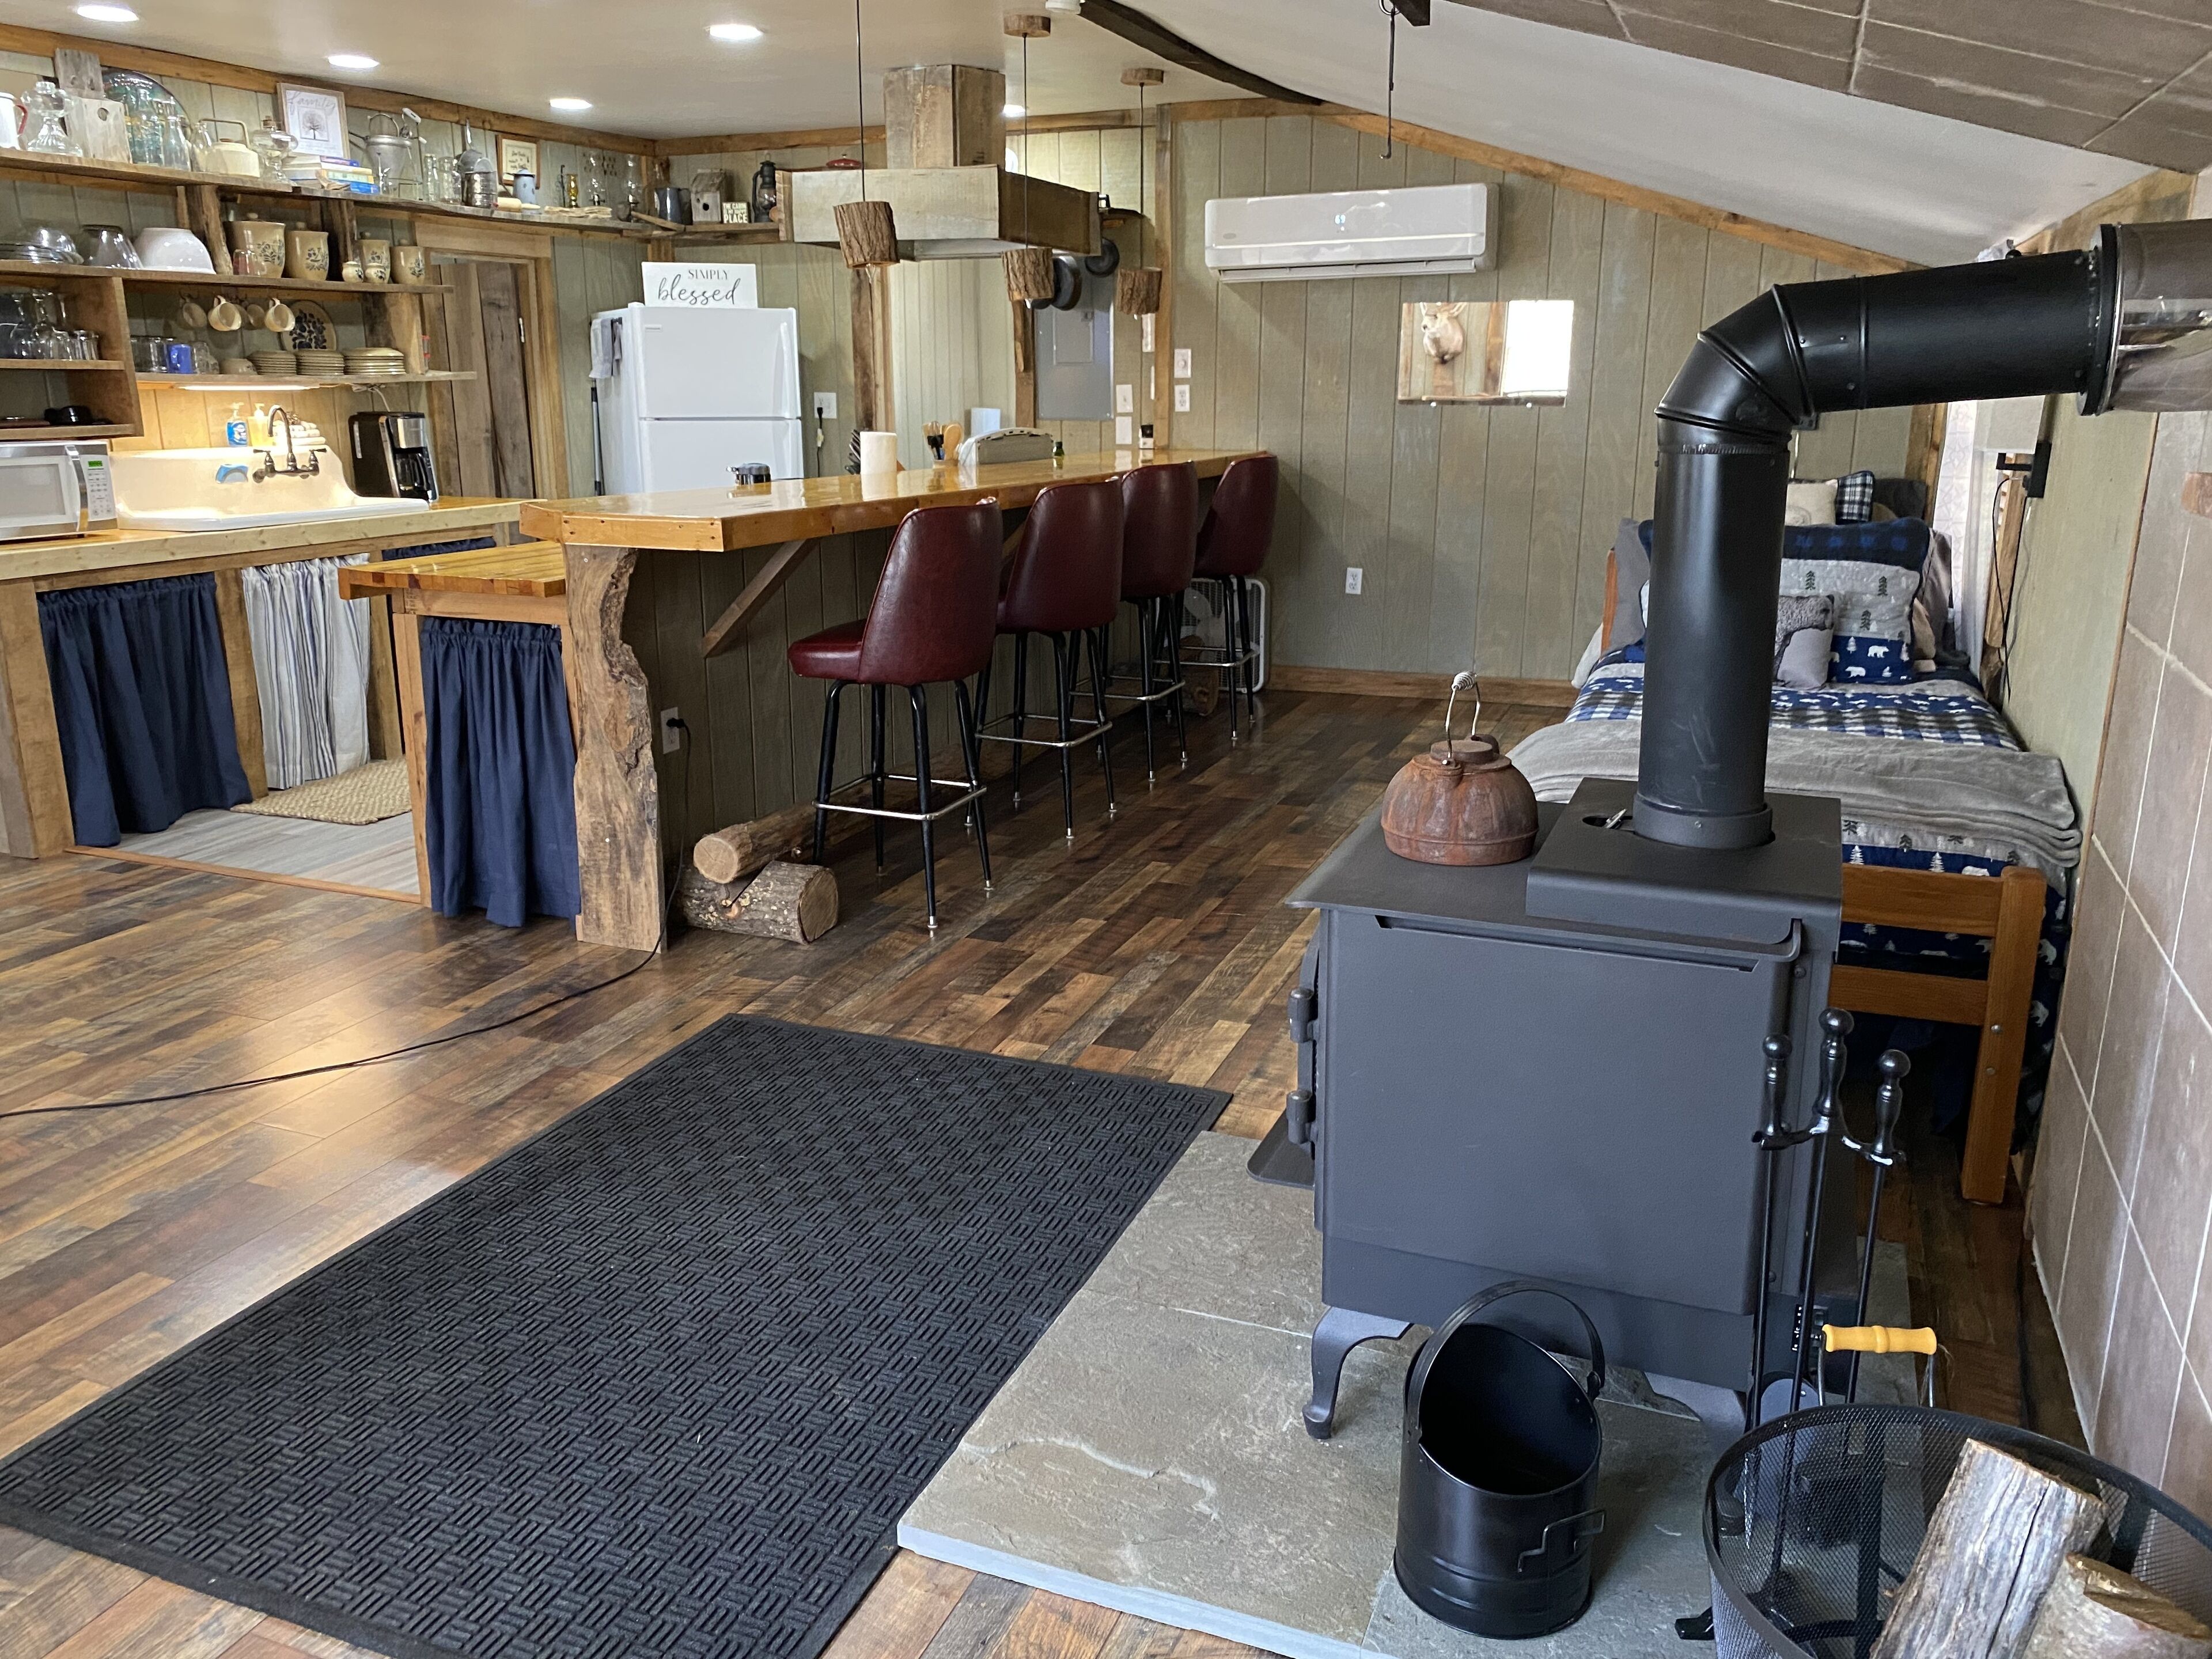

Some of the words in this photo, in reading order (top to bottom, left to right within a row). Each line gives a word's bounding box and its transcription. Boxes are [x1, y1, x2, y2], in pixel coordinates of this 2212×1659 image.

[724, 213, 748, 224] PLACE
[688, 269, 729, 279] SIMPLY
[658, 274, 741, 305] blessed
